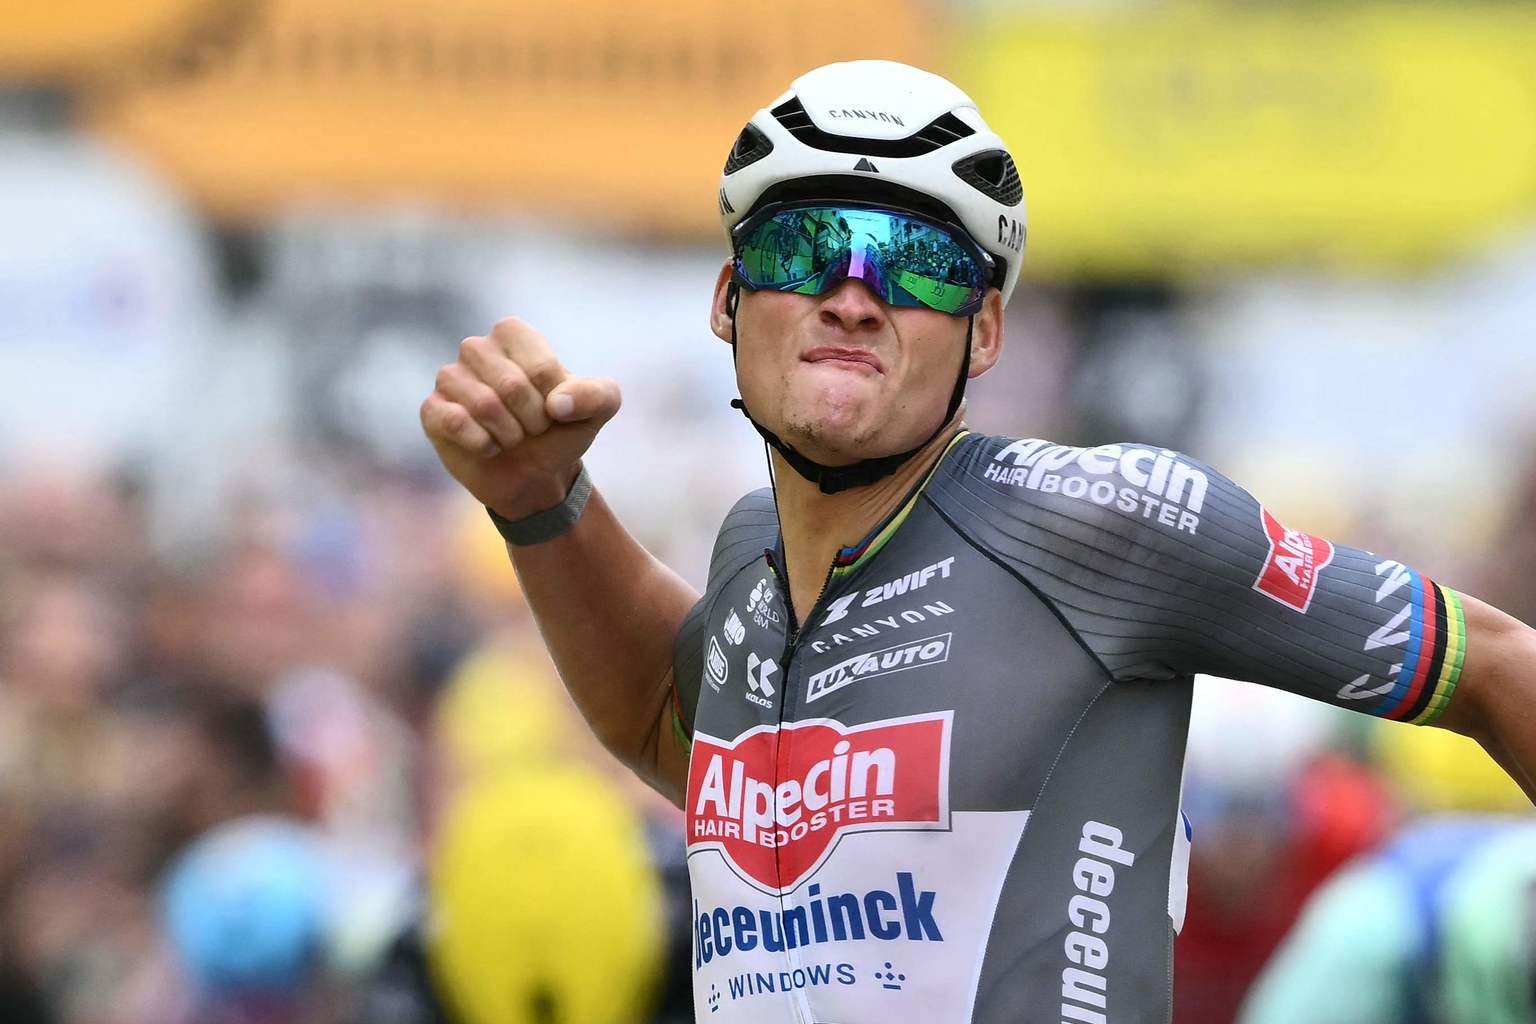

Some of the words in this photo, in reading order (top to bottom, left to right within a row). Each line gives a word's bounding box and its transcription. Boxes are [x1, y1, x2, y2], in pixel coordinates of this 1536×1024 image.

[828, 109, 905, 127] CANYON
[998, 214, 1027, 252] CAN
[983, 462, 1028, 488] HAIR
[1039, 473, 1200, 536] BOOSTER
[994, 438, 1209, 514] Alpecin
[861, 556, 955, 608] ZWIFT
[811, 600, 955, 654] CANYON
[696, 740, 896, 844] Alpecin
[695, 819, 740, 839] HAIR
[760, 799, 895, 848] BOOSTER
[694, 872, 944, 972] eceuninck
[728, 963, 856, 1000] WINDOWS
